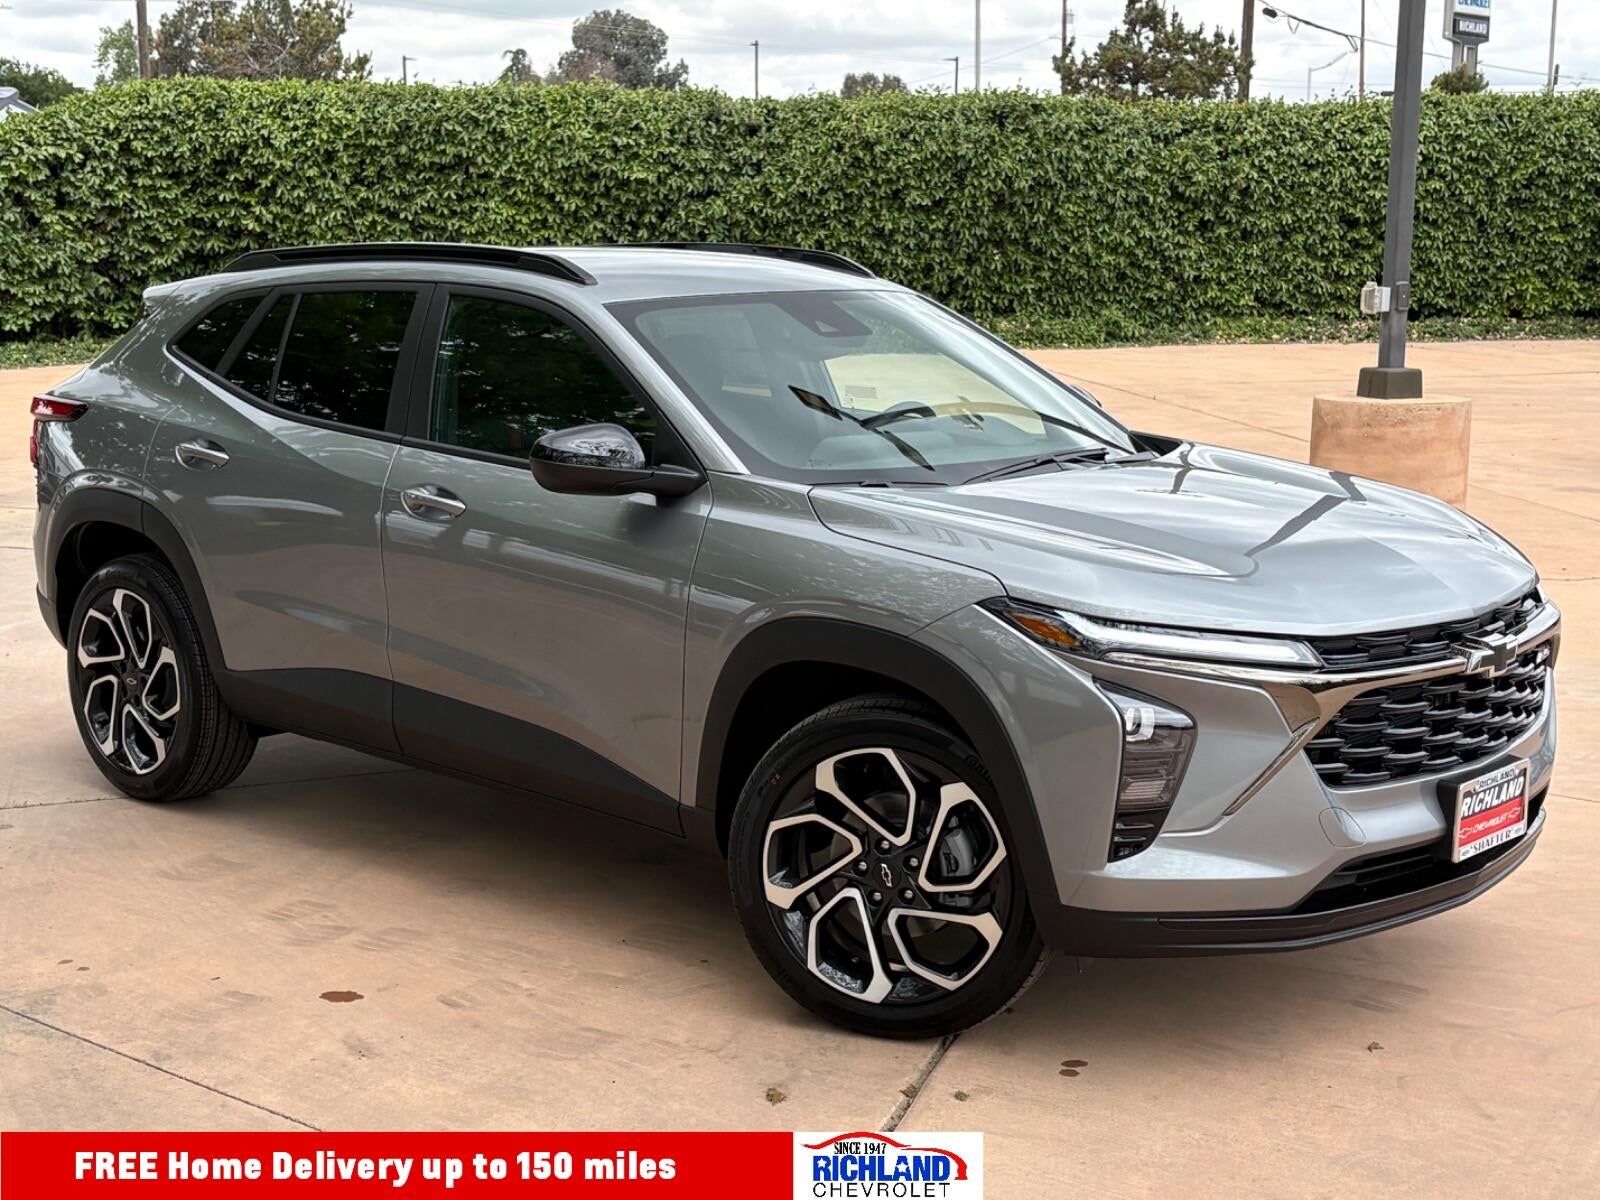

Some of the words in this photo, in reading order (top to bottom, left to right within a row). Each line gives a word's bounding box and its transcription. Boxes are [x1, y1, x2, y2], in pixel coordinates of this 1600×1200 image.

[1459, 20, 1488, 34] RICHLAND
[1478, 767, 1515, 788] RICHLAND
[1461, 776, 1524, 817] RICHLAND
